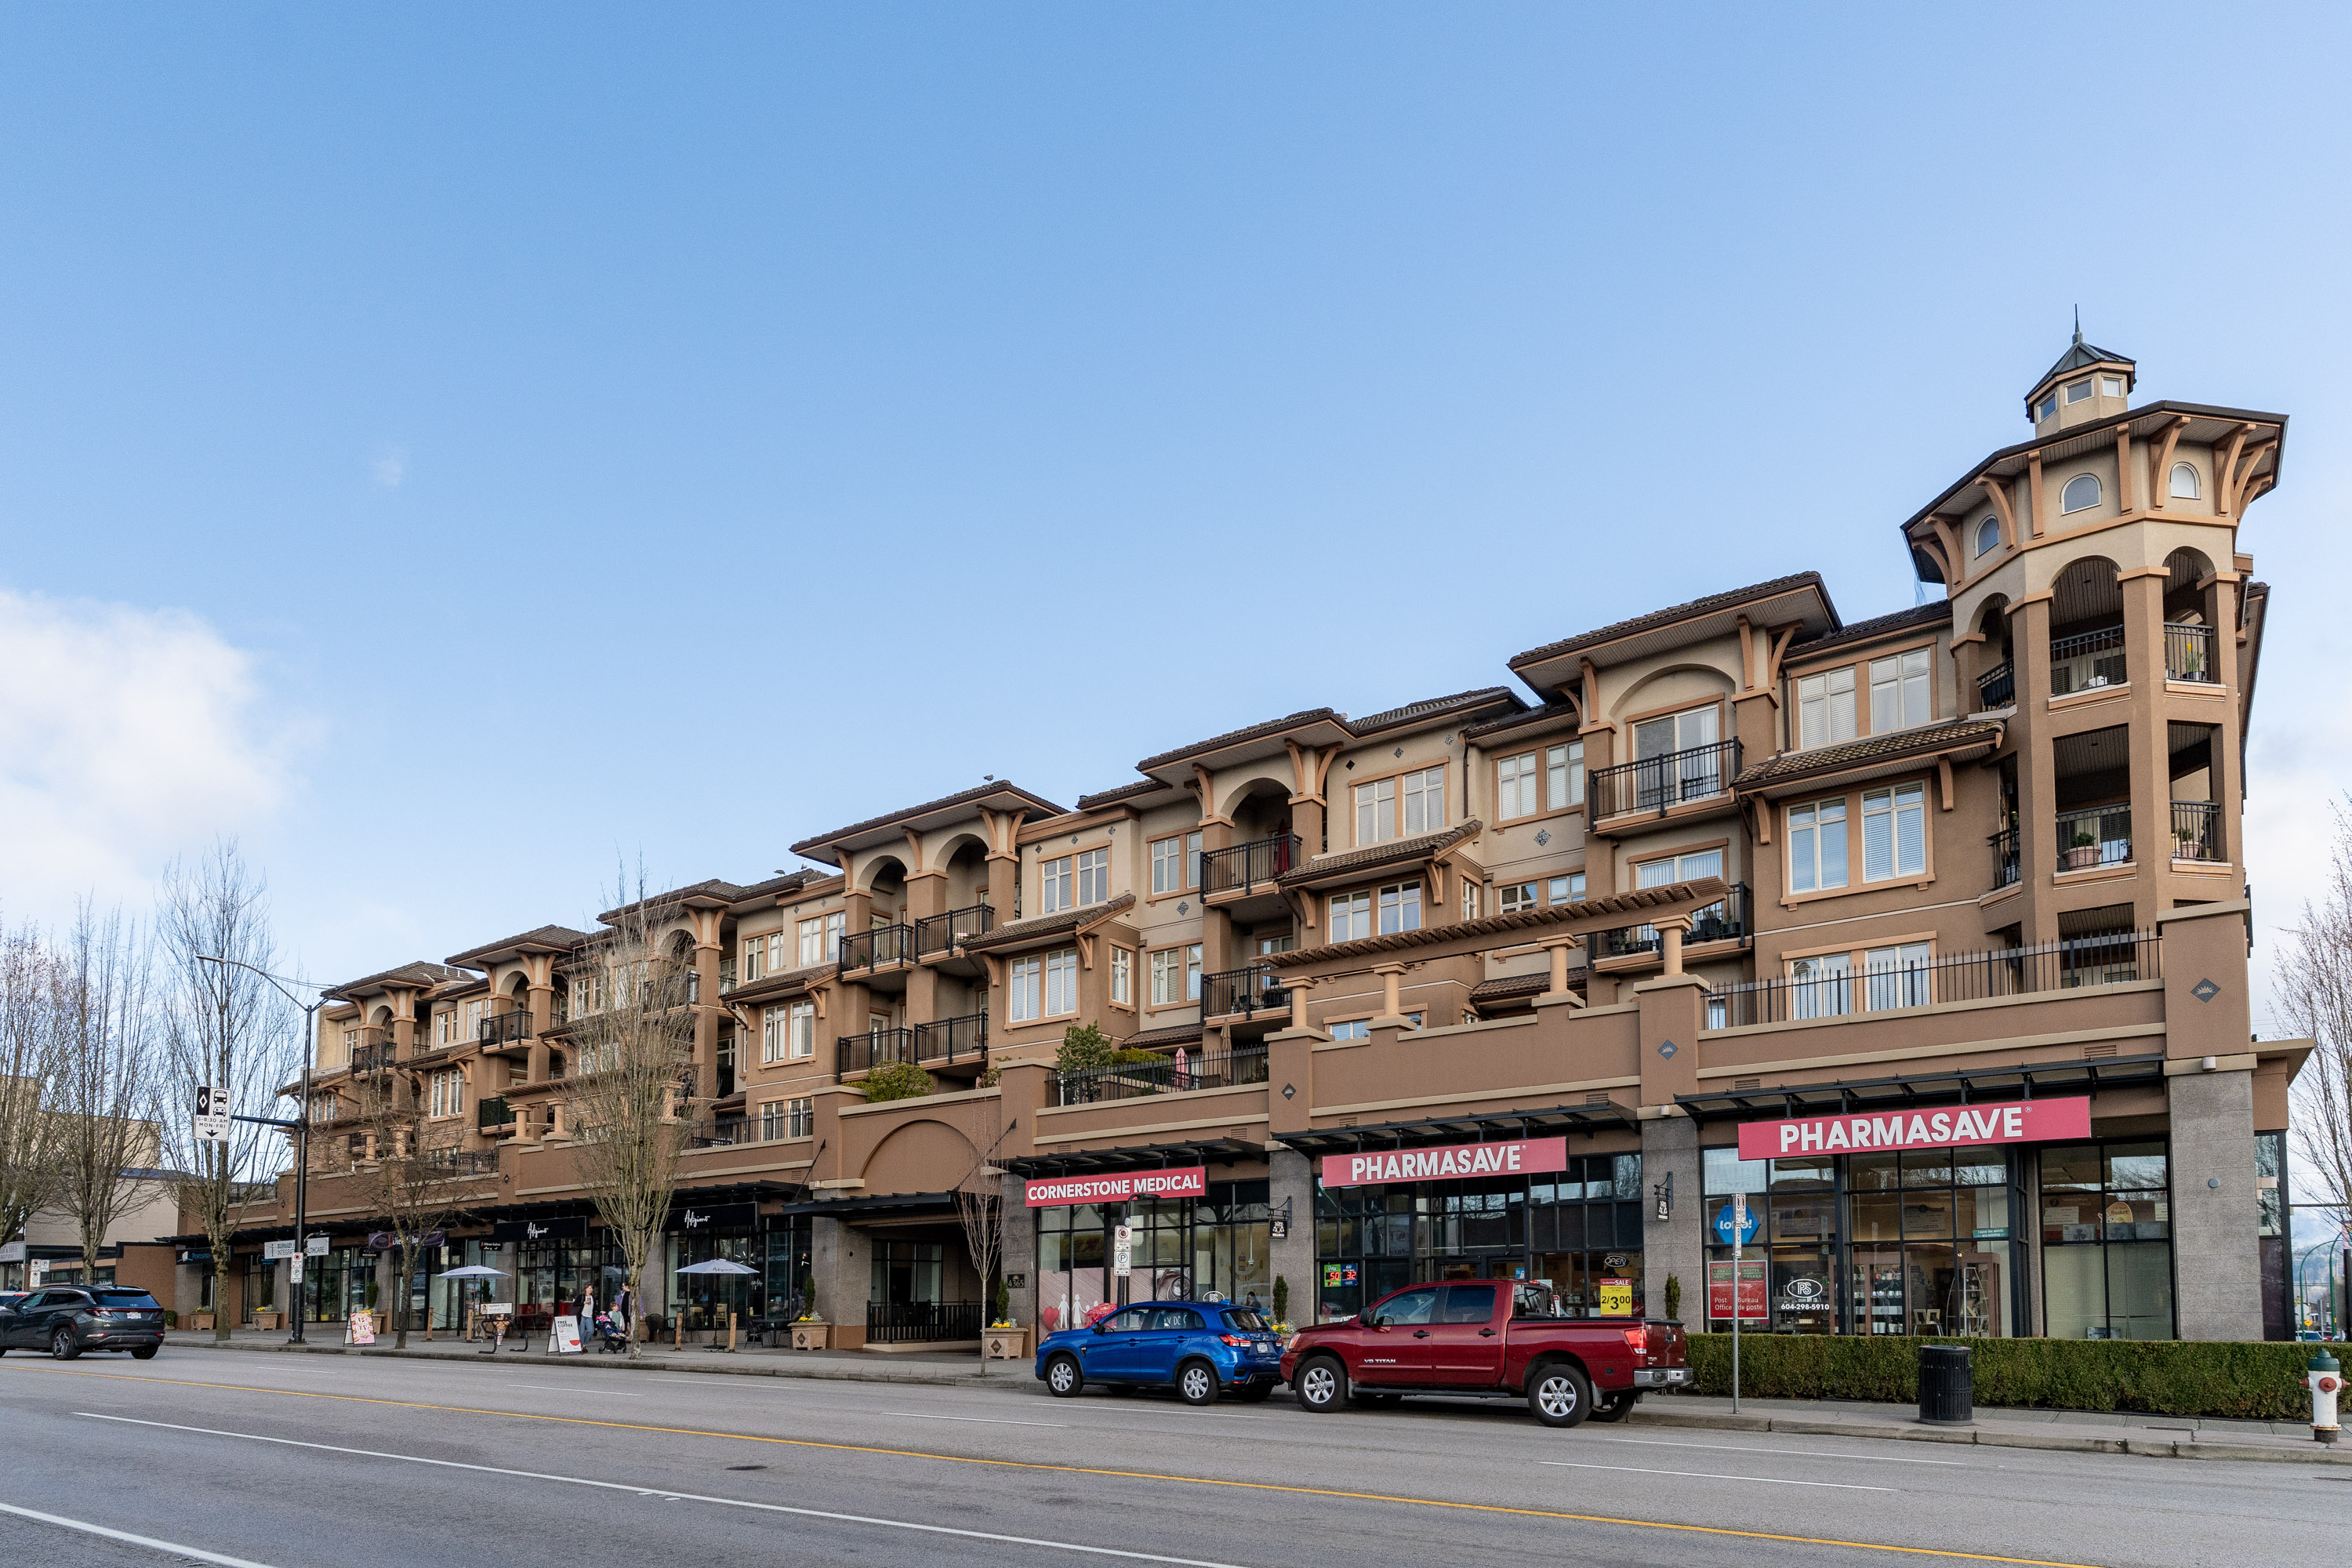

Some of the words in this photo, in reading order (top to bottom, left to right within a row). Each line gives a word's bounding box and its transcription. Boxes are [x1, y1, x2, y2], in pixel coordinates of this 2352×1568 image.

[1780, 1106, 2023, 1152] PHARMASAVE
[1352, 1145, 1520, 1181] PHARMASAVE
[1028, 1179, 1131, 1201] CORNERSTONE
[1134, 1174, 1201, 1193] MEDICAL
[1719, 1218, 1753, 1229] loo!
[1330, 1272, 1340, 1280] 50
[1346, 1271, 1357, 1279] 32
